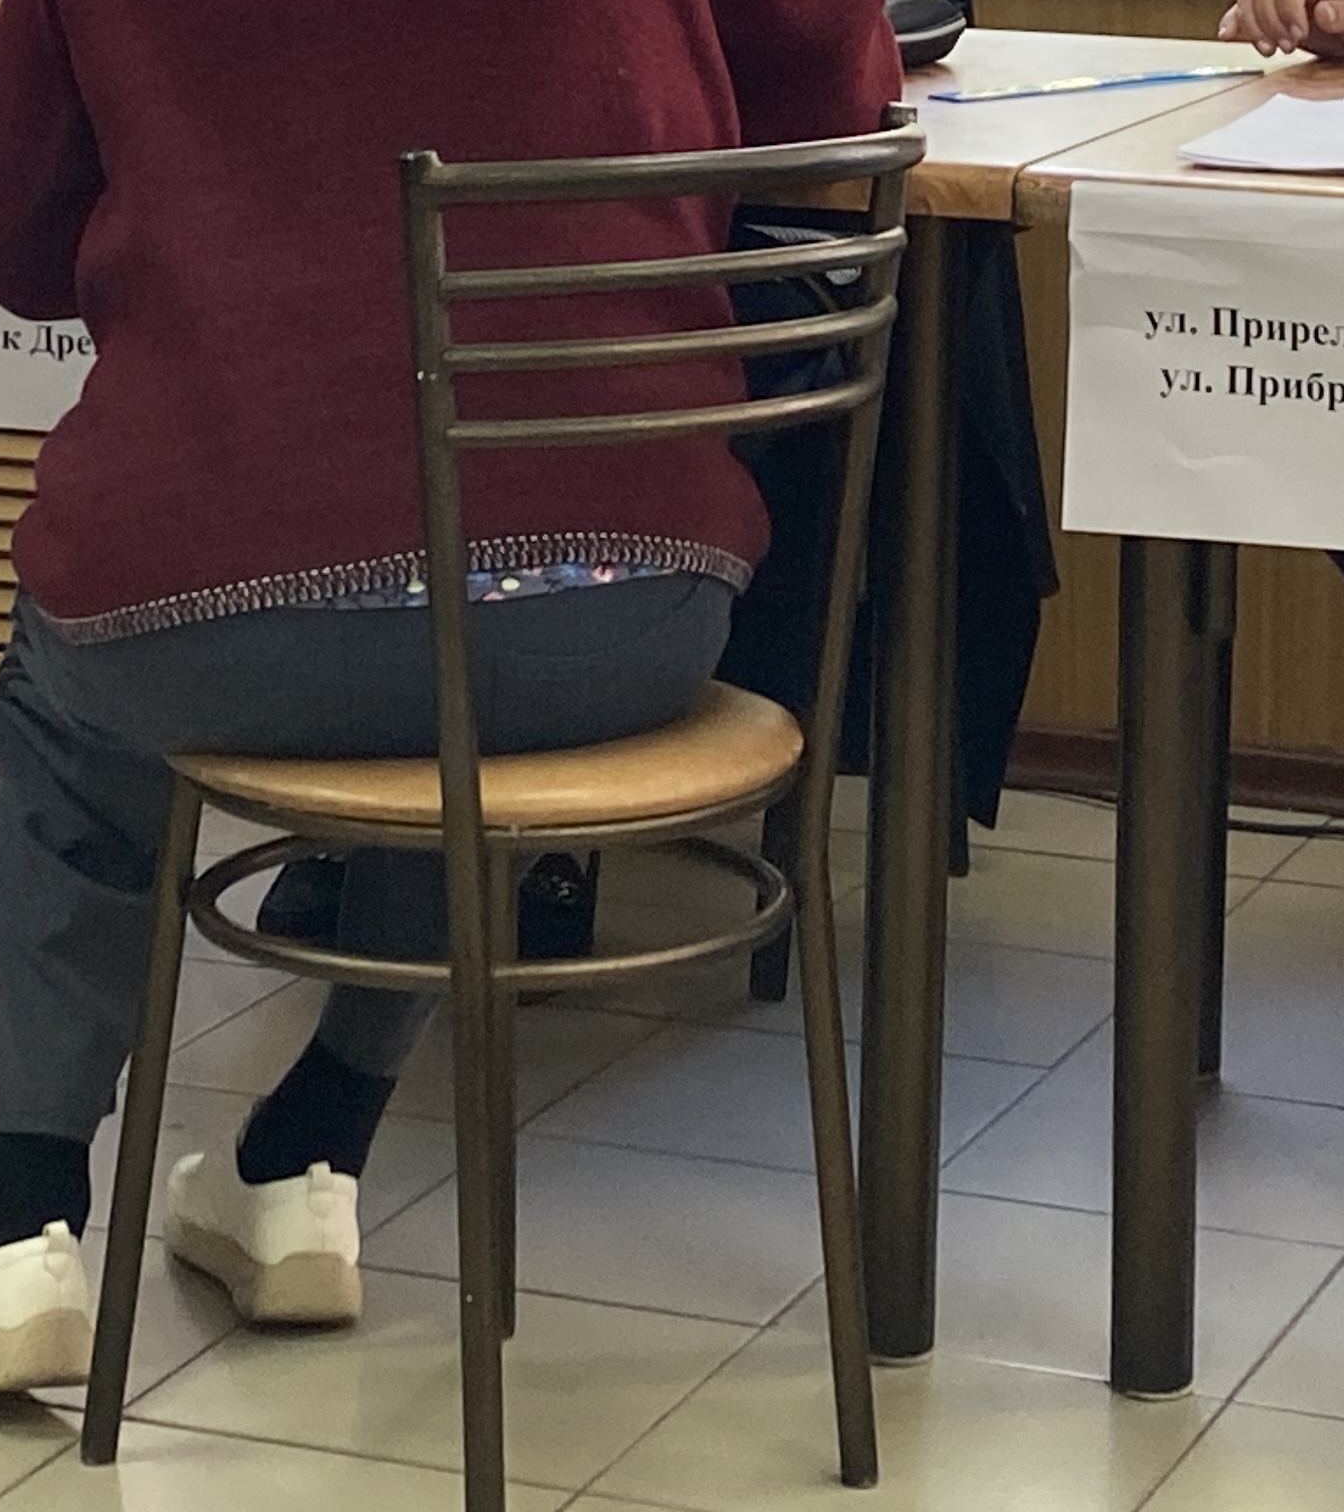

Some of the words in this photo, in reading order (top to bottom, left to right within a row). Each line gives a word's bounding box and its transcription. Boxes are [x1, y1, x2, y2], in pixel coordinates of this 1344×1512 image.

[1144, 309, 1198, 340] ул.
[30, 325, 98, 362] Дре
[1159, 367, 1213, 398] ул.
